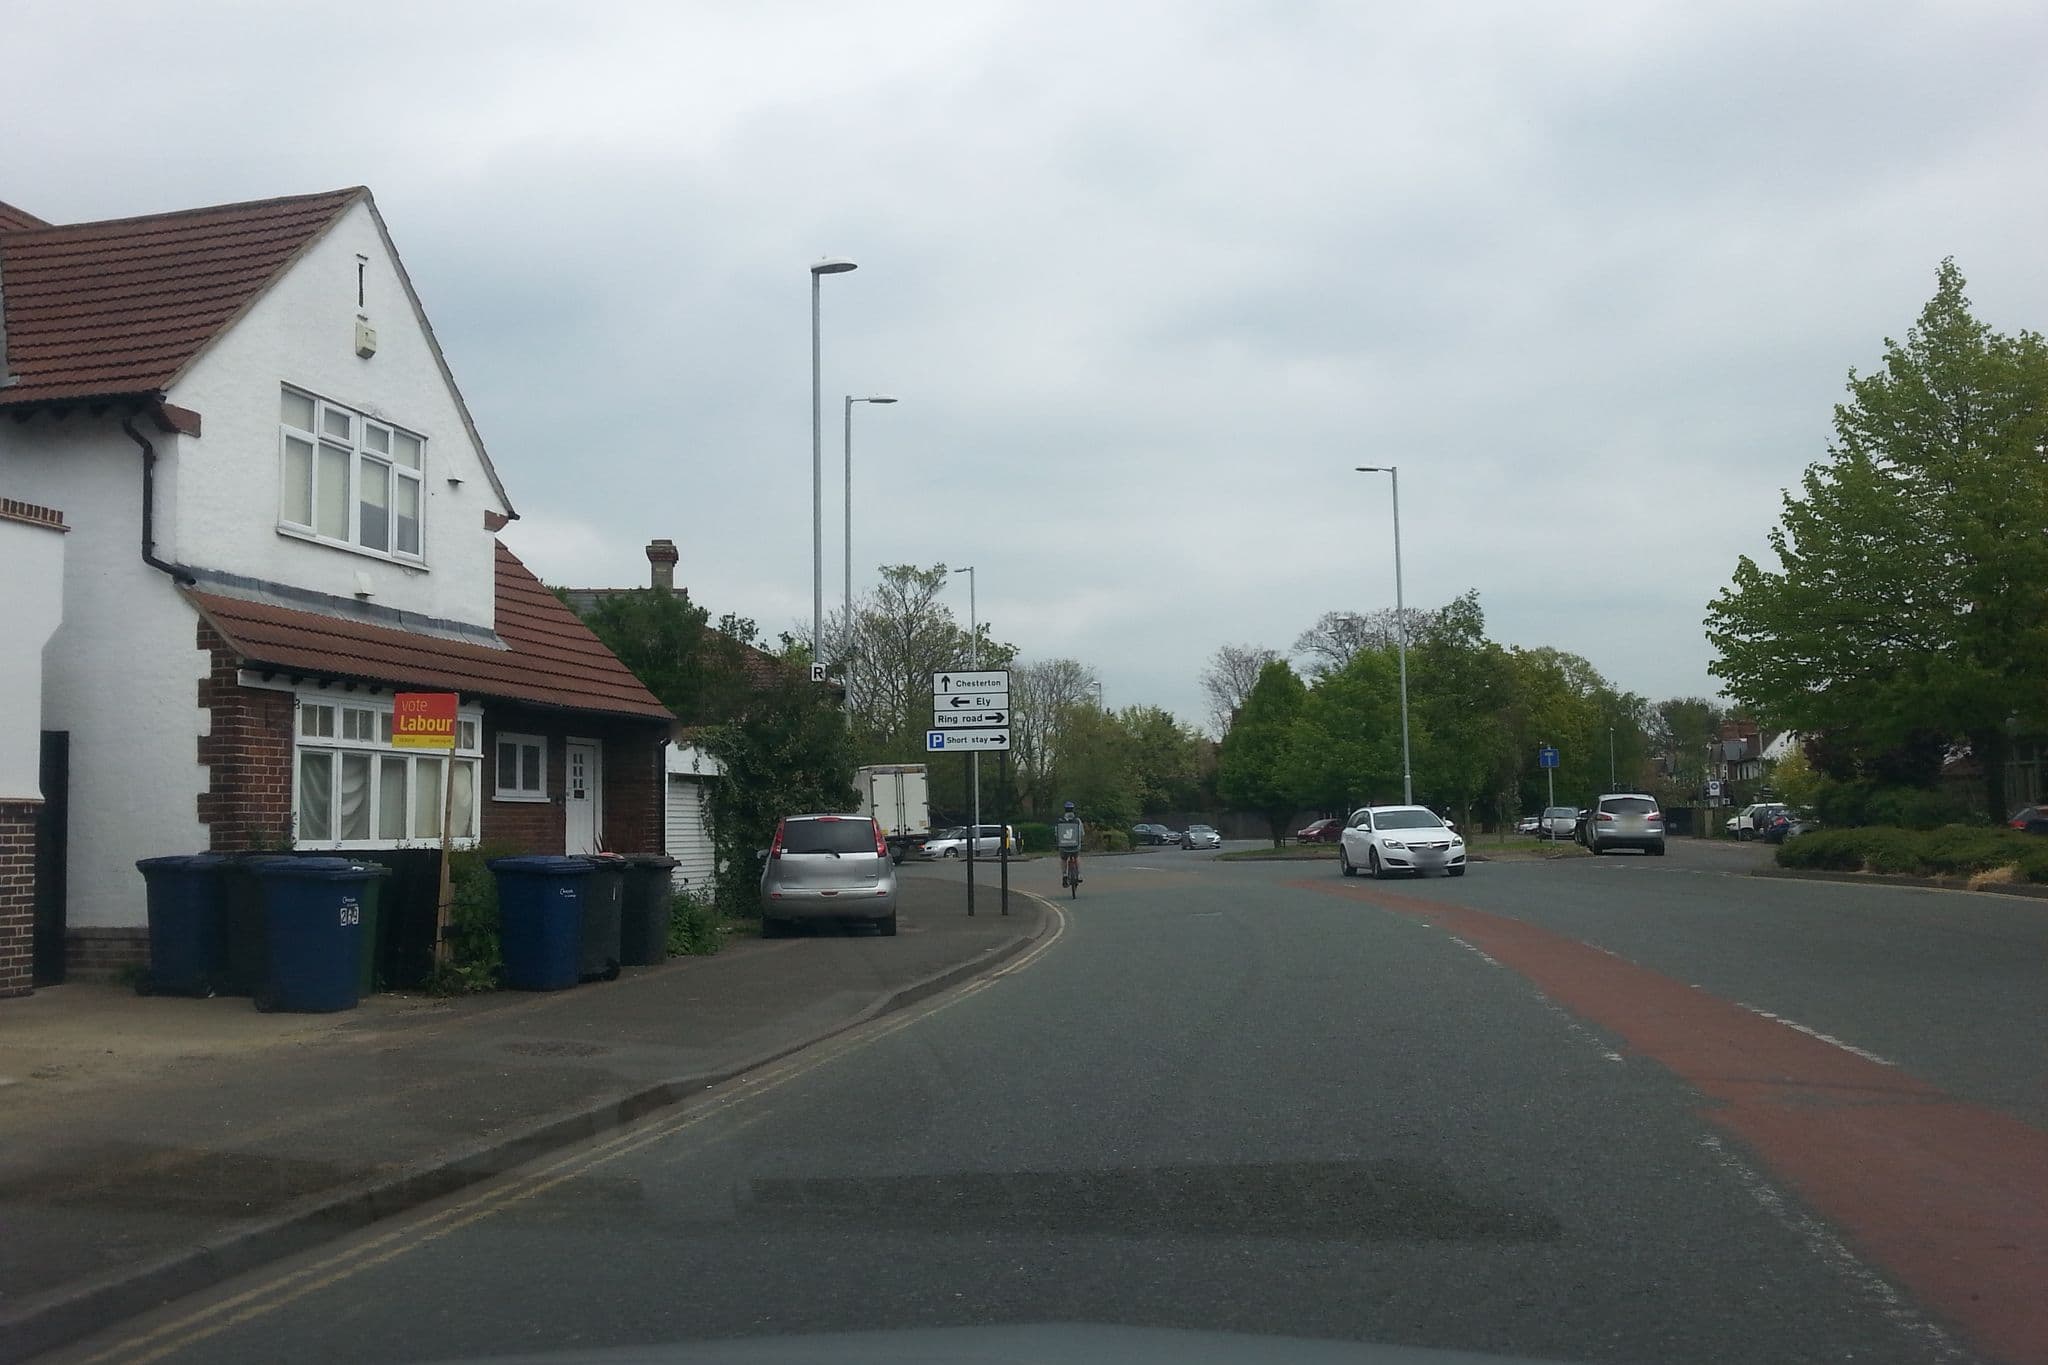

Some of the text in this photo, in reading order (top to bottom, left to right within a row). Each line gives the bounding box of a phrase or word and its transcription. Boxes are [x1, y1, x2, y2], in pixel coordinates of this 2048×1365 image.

[813, 666, 823, 679] R
[955, 679, 1001, 688] Chesterton
[401, 699, 428, 712] vote
[976, 697, 991, 706] Ely
[400, 714, 454, 732] Labour
[937, 713, 983, 724] Ring road
[933, 734, 989, 747] P Short stay
